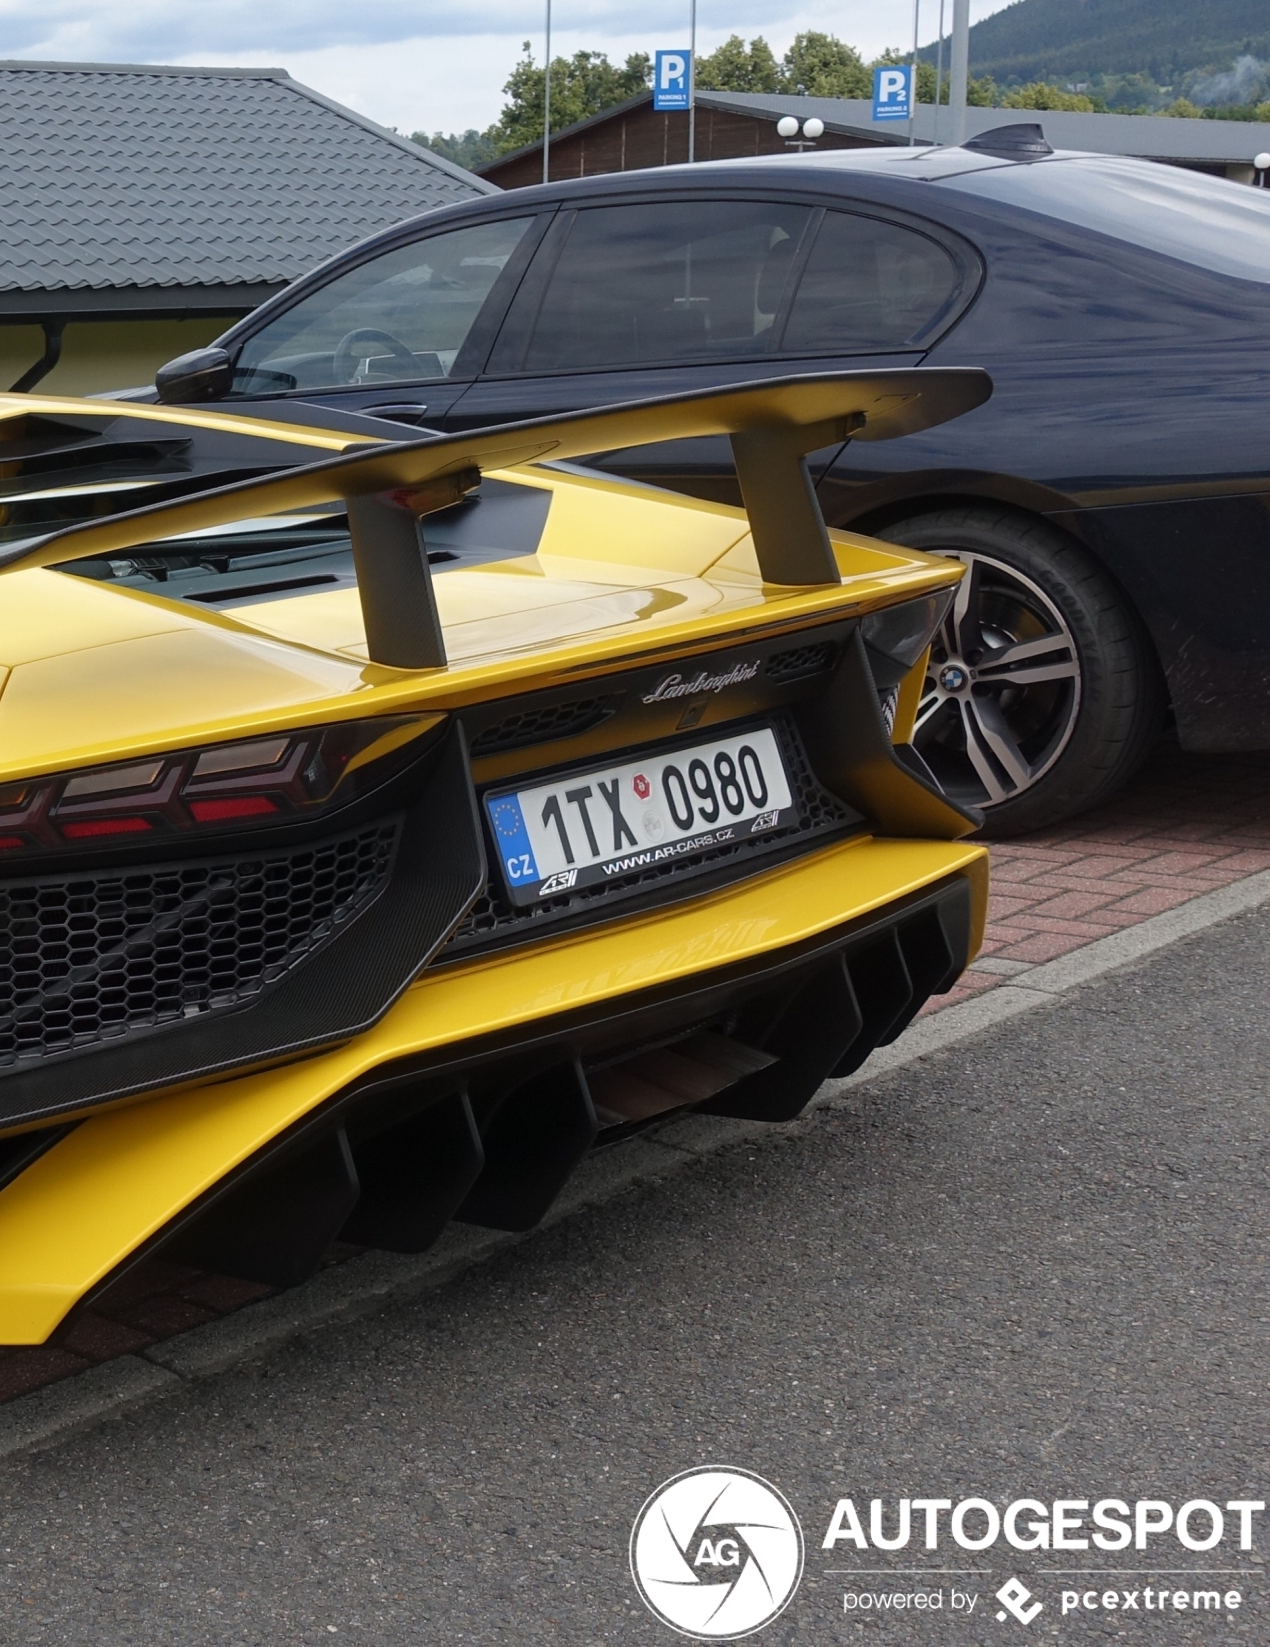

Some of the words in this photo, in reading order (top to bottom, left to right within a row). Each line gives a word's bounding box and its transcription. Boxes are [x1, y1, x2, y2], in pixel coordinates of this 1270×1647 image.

[642, 660, 760, 703] Lamborghini
[540, 777, 639, 865] 1TX
[661, 745, 769, 832] 0980
[506, 853, 534, 880] CZ
[602, 827, 735, 876] WWW.AR-CARS.CZ
